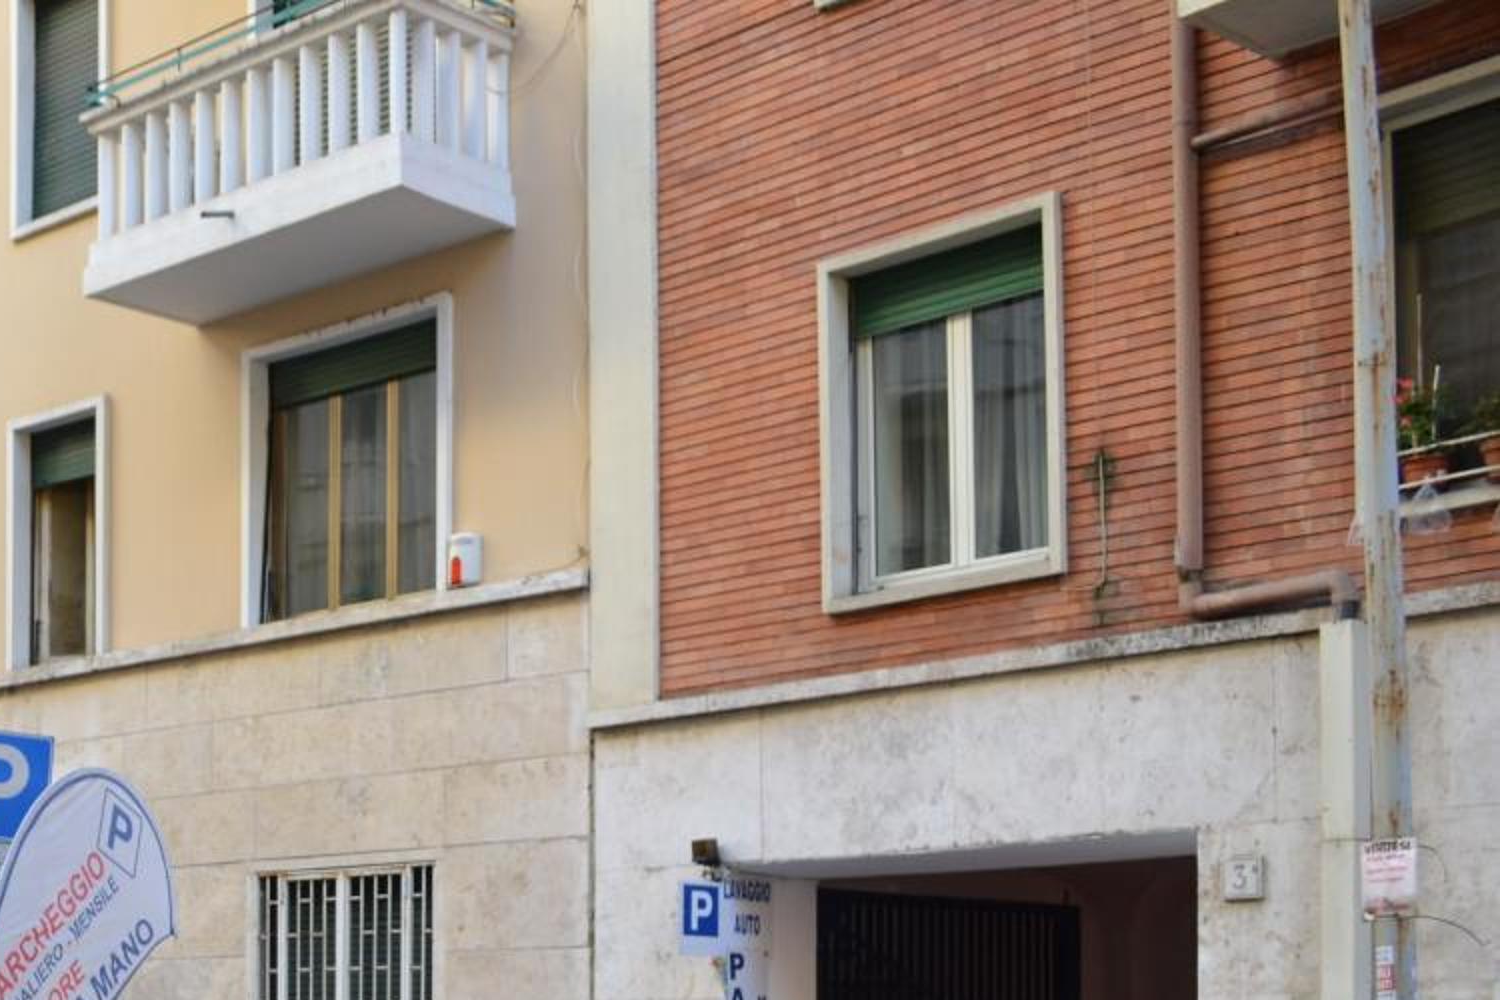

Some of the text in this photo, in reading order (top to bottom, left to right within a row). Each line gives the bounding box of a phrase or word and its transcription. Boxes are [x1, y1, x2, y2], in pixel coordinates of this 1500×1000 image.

[107, 804, 133, 850] P
[68, 877, 120, 943] MENSILE
[691, 890, 713, 931] P
[723, 880, 771, 903] LAVAGGIO
[734, 914, 761, 936] AUTO
